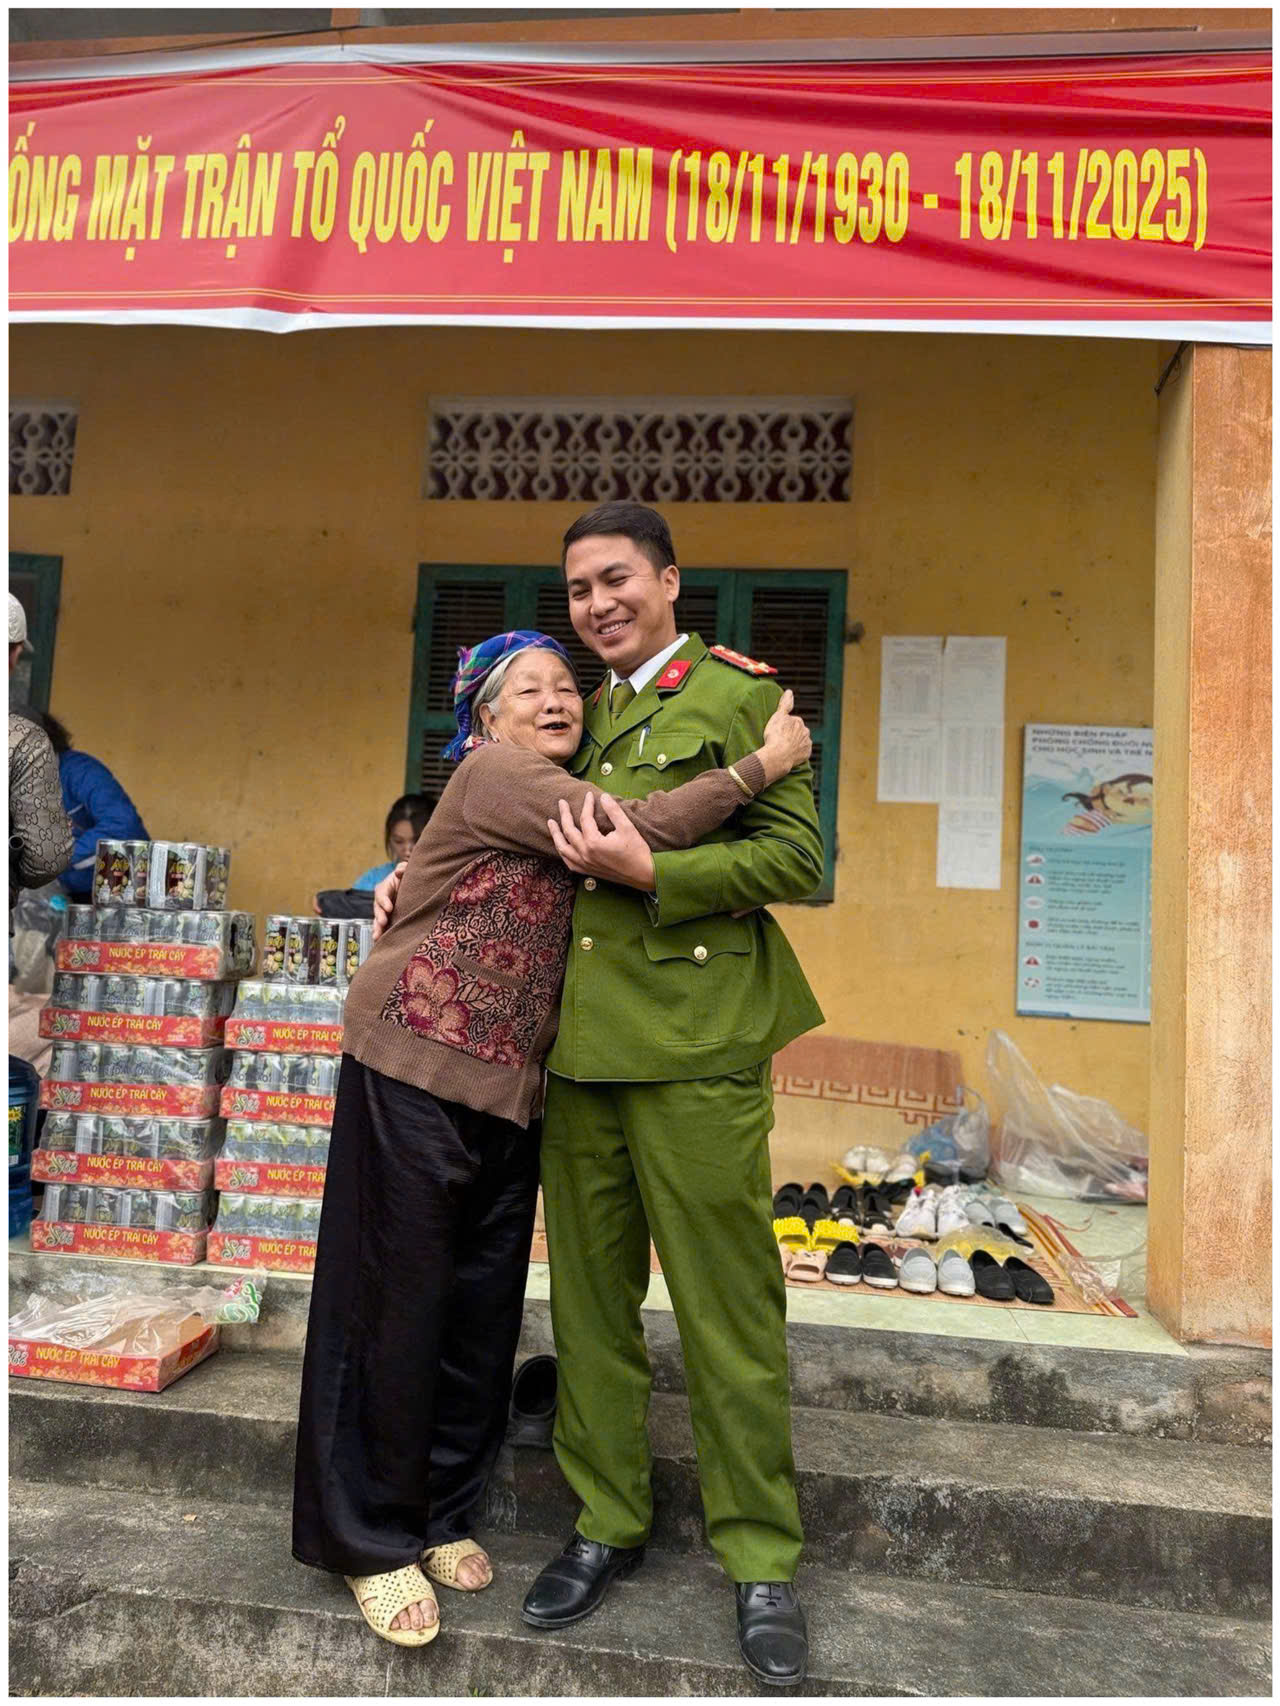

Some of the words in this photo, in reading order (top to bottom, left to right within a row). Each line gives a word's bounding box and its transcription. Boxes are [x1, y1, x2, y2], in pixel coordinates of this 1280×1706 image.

[9, 121, 81, 242] ỐNG
[86, 136, 175, 261] MẶT
[182, 133, 282, 258] TRẬN
[291, 115, 346, 242] TỔ
[348, 119, 455, 254] QUỐC
[466, 130, 551, 263] VIỆT
[556, 148, 653, 242] NAM
[665, 148, 911, 253] (18/11/1930
[923, 193, 939, 210] -
[954, 146, 1209, 252] 18/11/2025)
